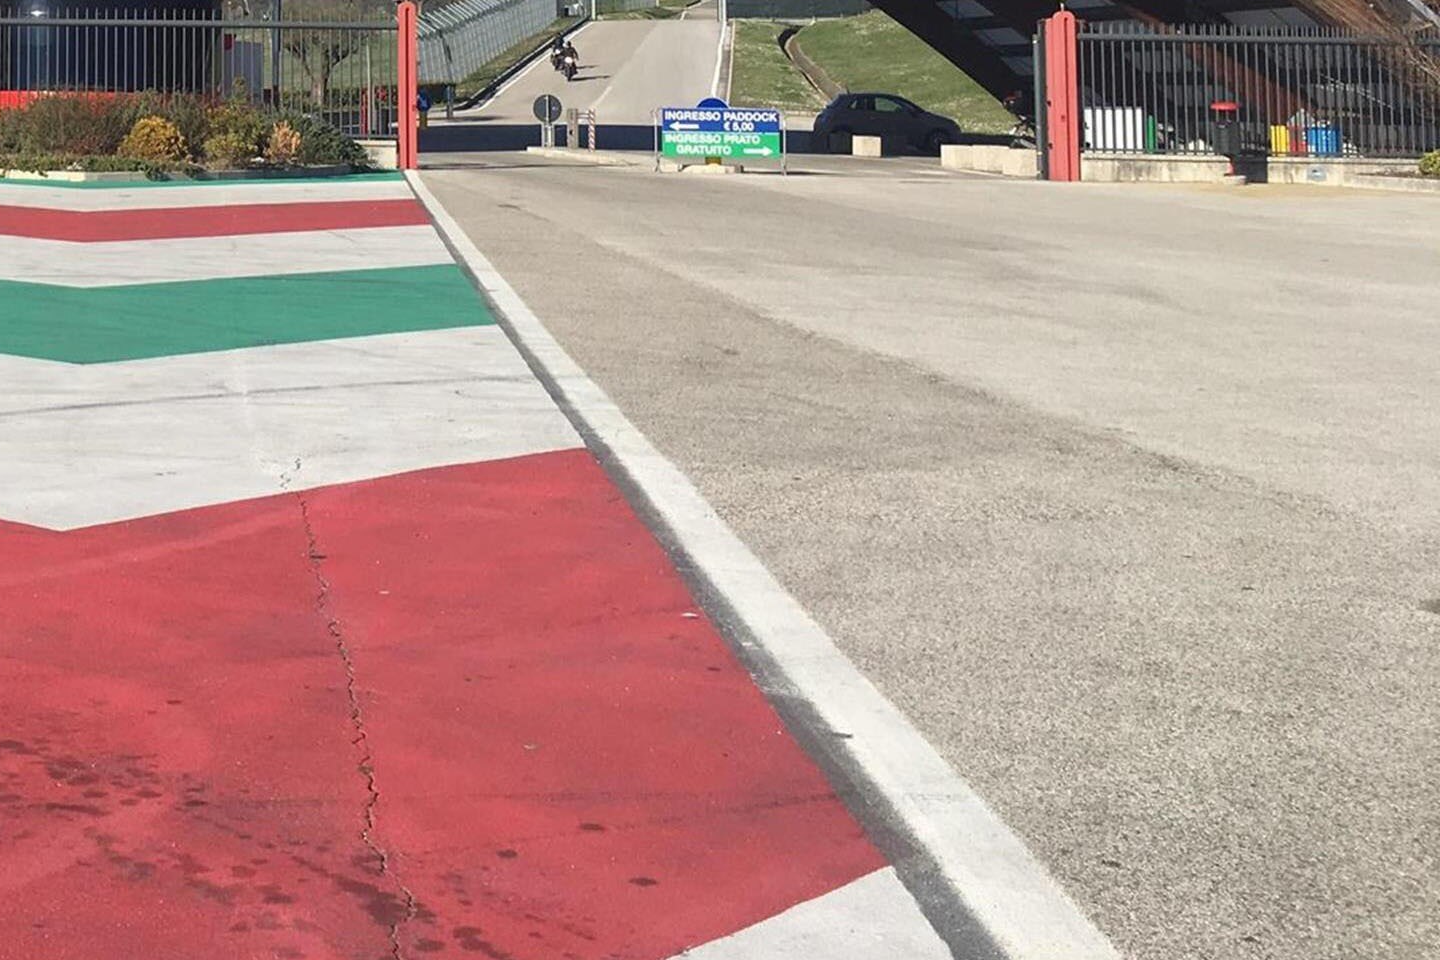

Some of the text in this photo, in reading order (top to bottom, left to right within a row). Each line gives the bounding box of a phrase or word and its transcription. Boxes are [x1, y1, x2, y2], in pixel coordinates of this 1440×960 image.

[664, 110, 777, 122] INGRESSO PADDOCK
[732, 122, 755, 132] 5,00
[664, 134, 760, 144] INGRESSO PRATO
[676, 144, 732, 155] GRATUITO
